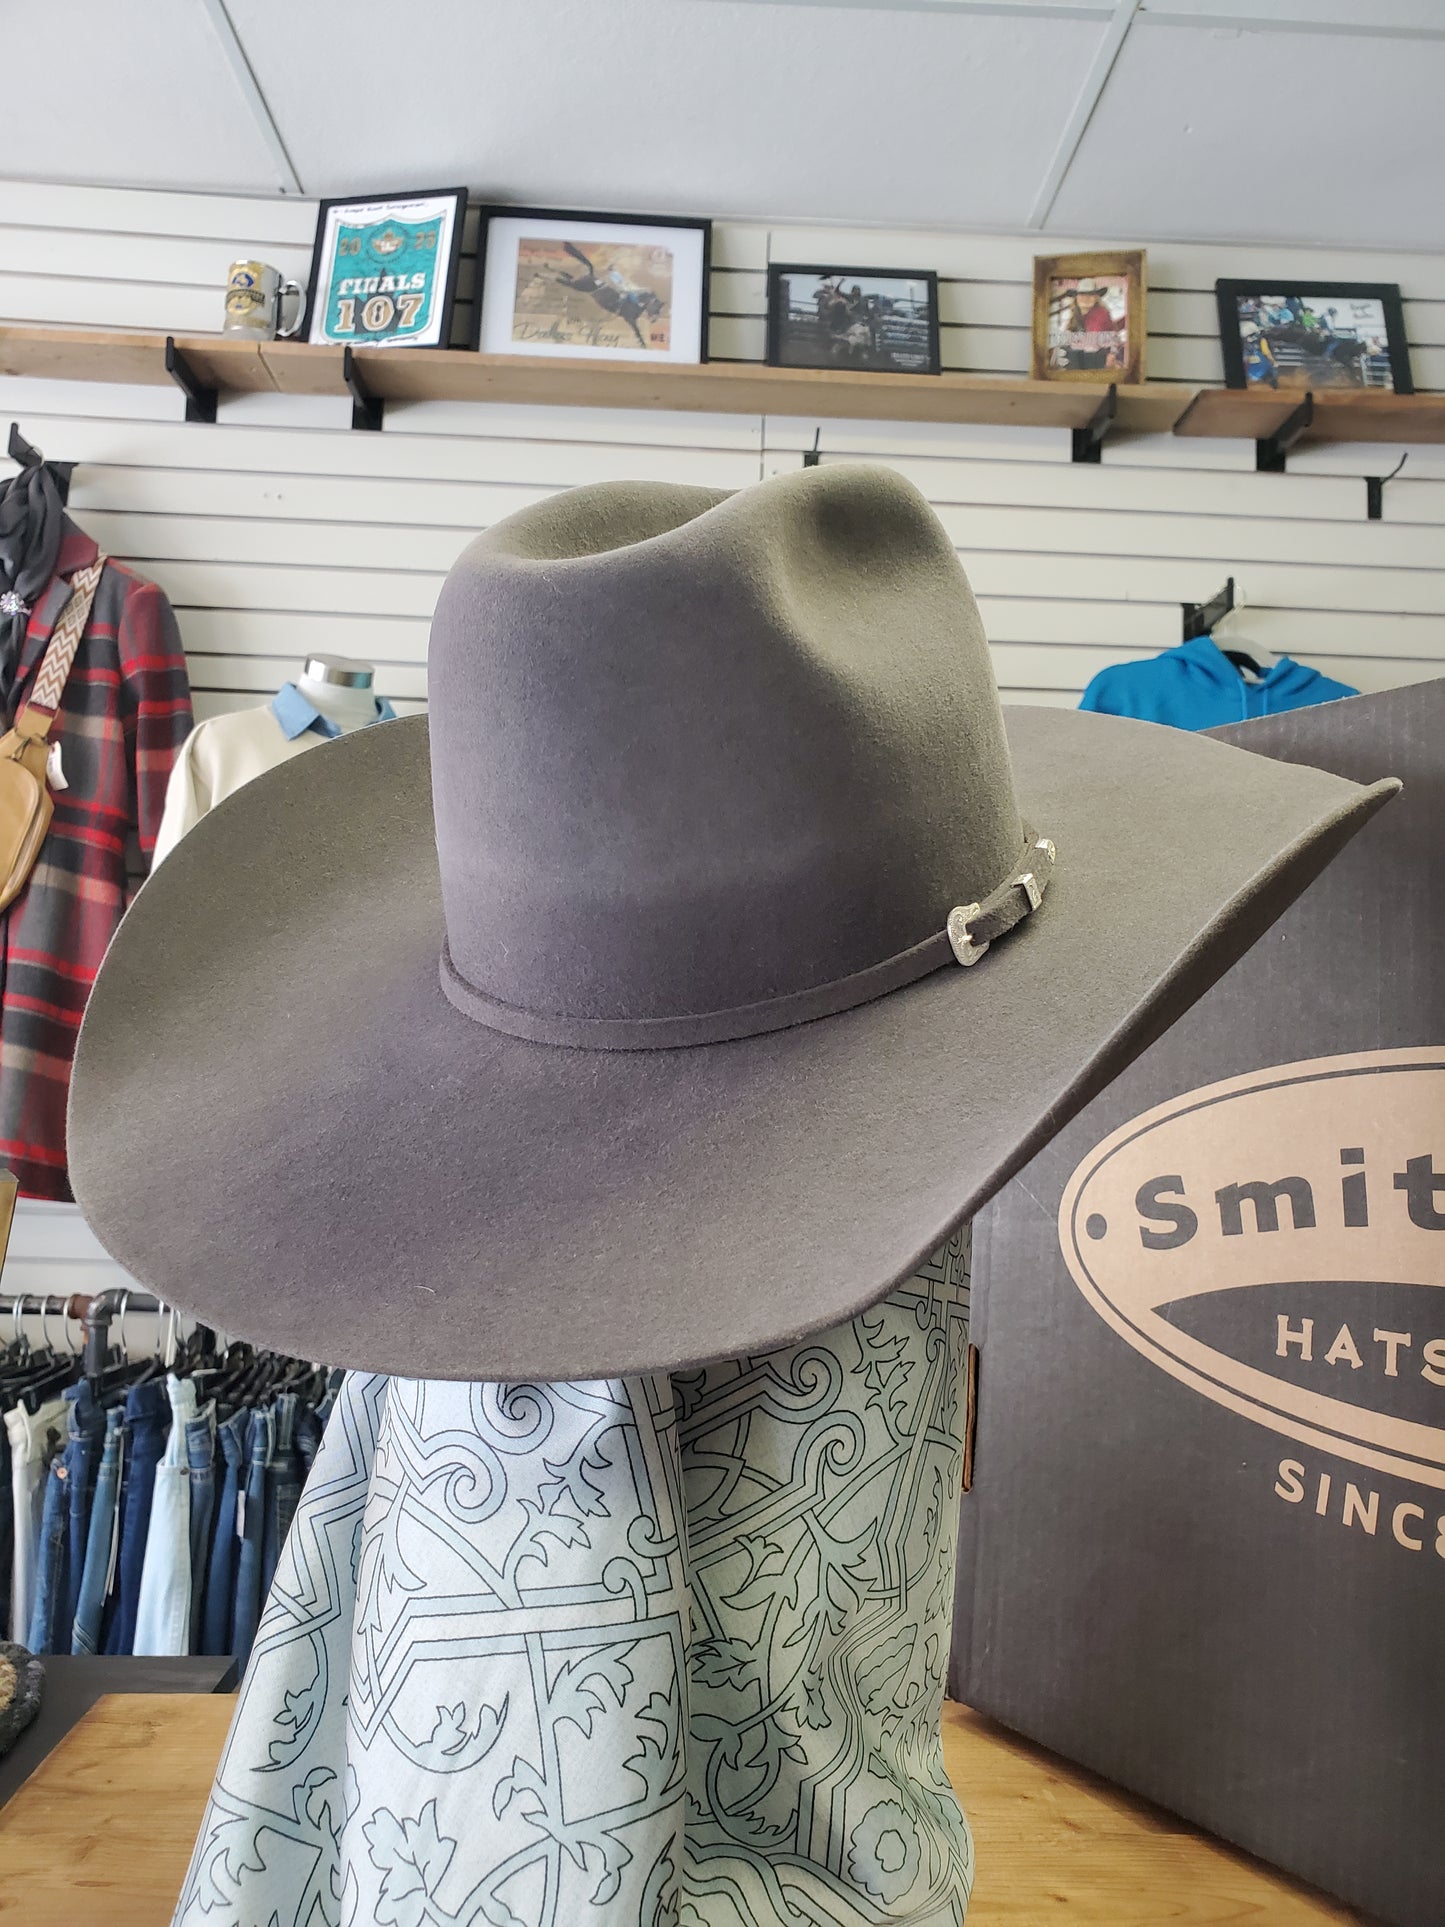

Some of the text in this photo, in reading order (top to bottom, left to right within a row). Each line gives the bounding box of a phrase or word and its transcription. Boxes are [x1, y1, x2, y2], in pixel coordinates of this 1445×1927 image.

[338, 237, 362, 256] 20
[337, 272, 426, 296] FINALS
[333, 293, 426, 333] 107
[1134, 1147, 1445, 1251] Smit
[1275, 1314, 1445, 1387] HATS
